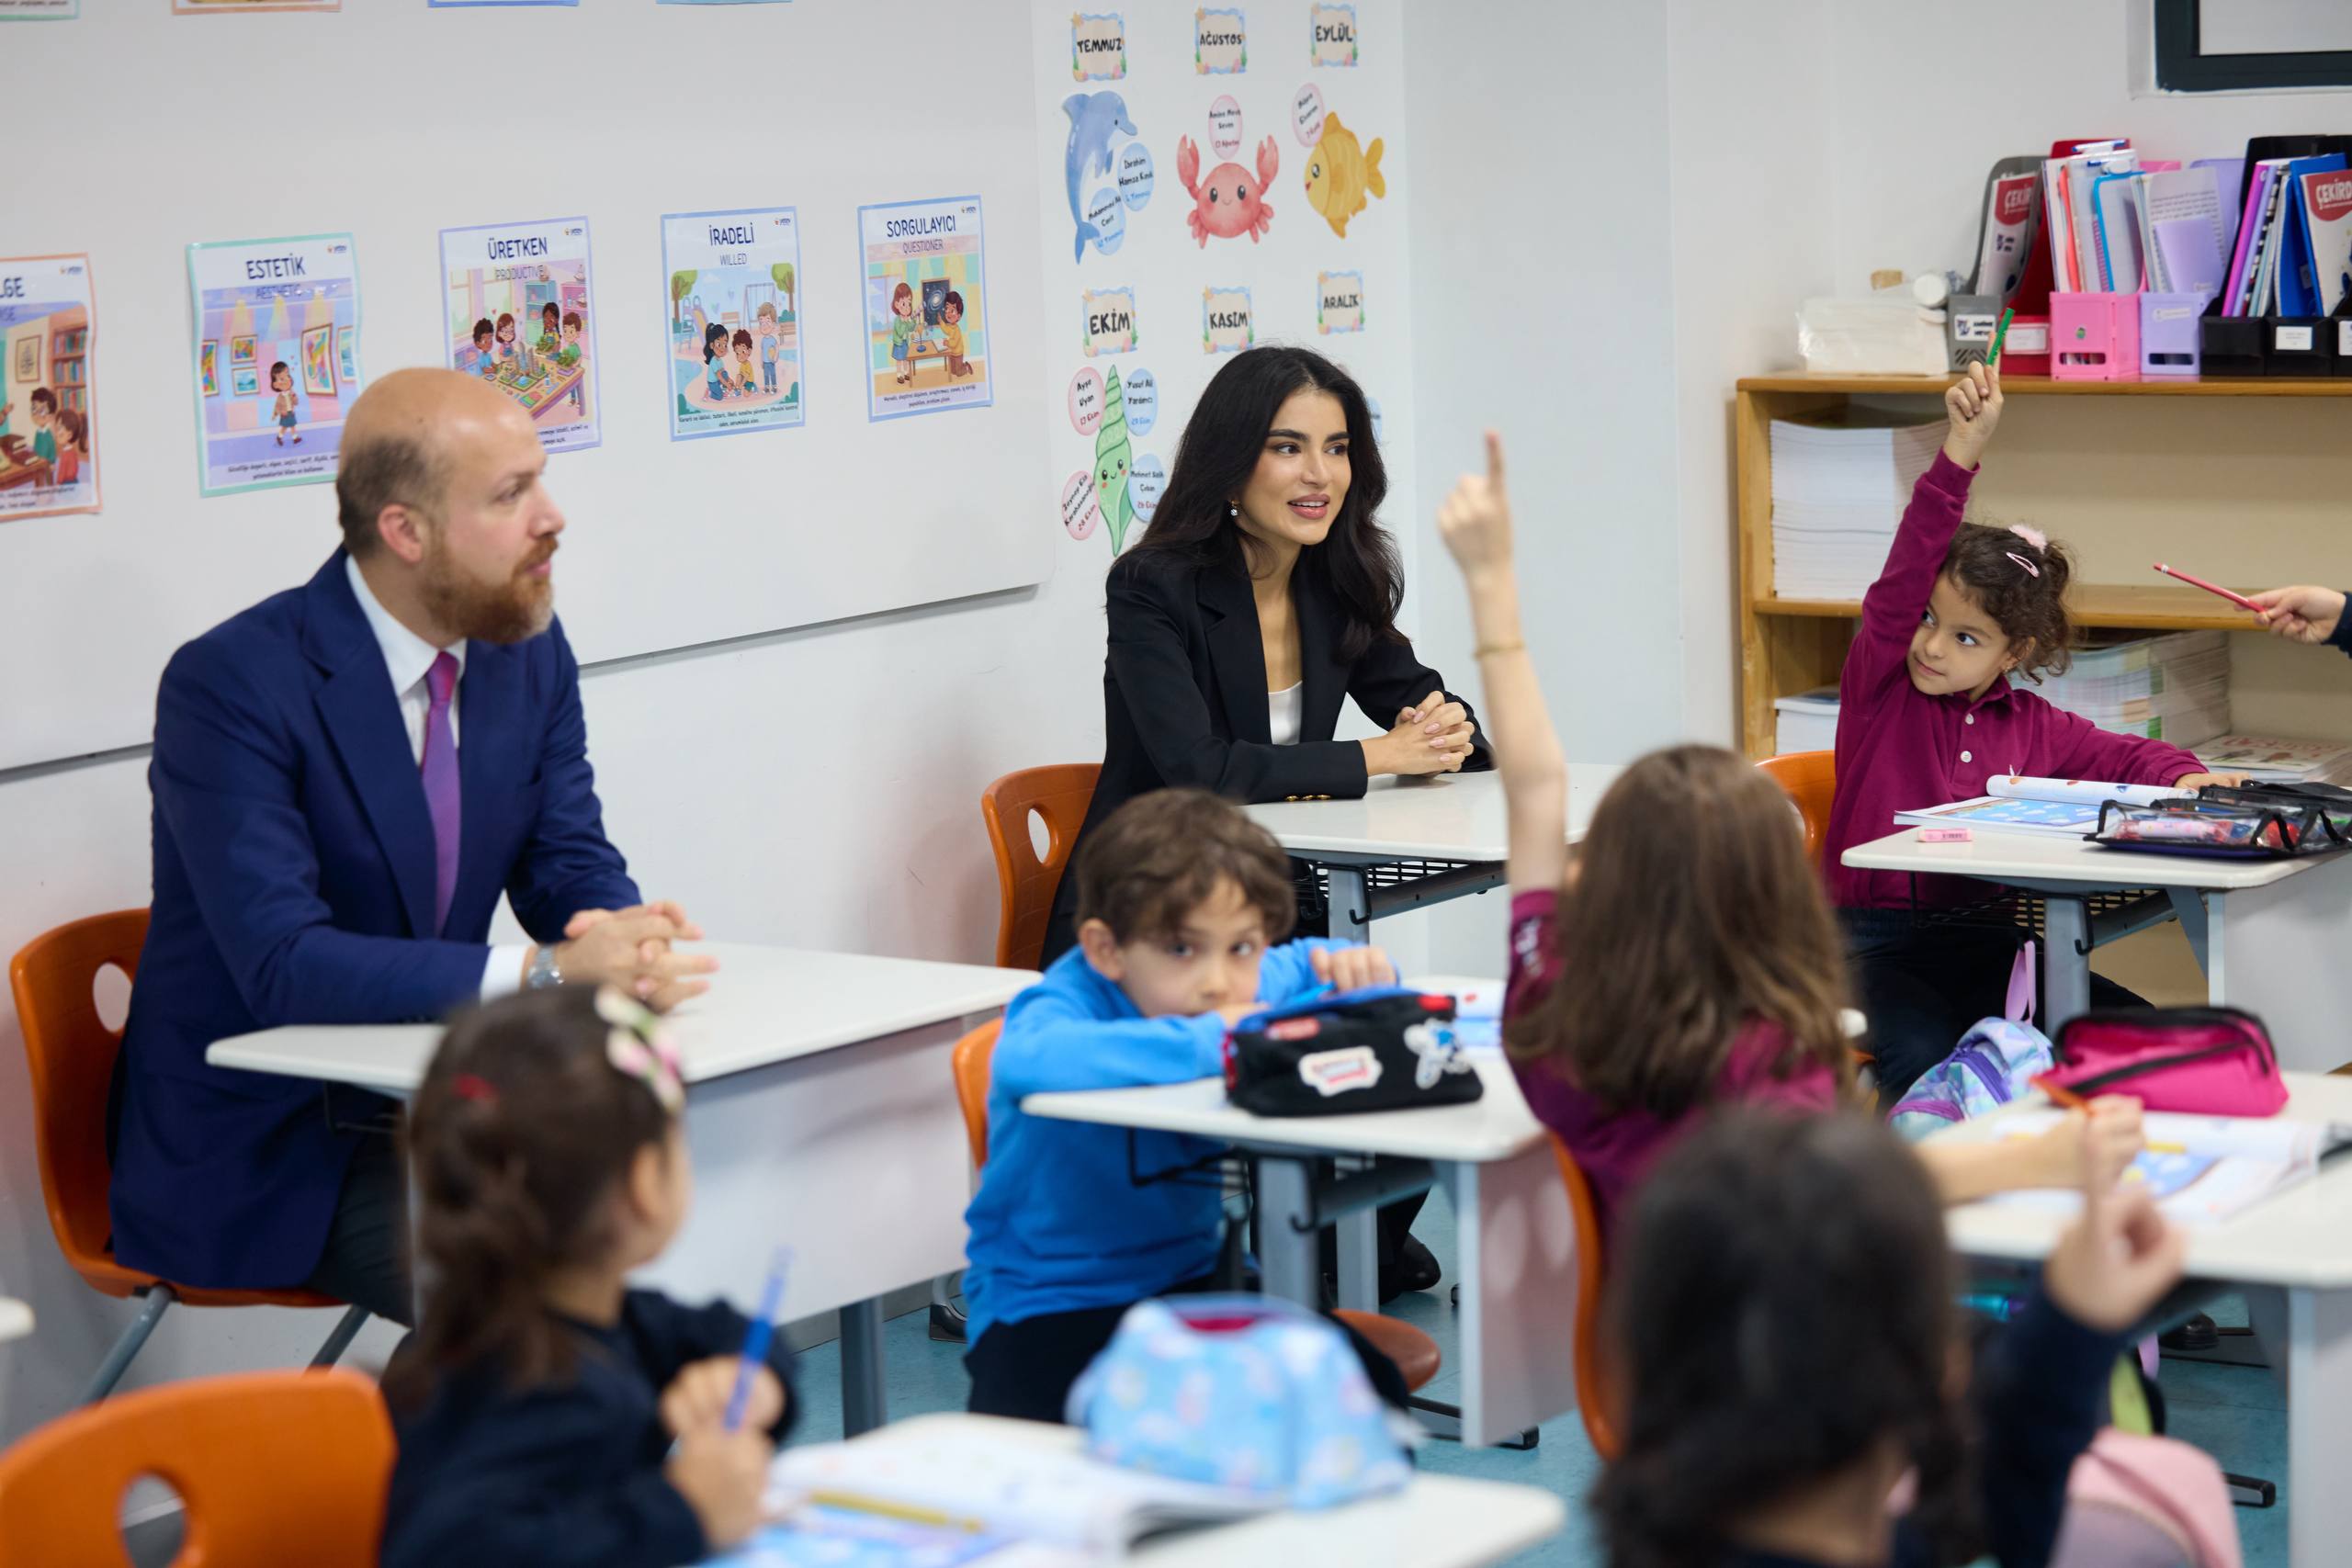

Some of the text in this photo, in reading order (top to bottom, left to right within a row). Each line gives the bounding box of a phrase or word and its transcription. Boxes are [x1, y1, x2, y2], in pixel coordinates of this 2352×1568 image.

[1200, 30, 1242, 46] AĞUSTOS
[1315, 22, 1353, 42] EYLÜL
[1077, 37, 1123, 53] TEMMUZ
[708, 221, 754, 246] İRADELİ
[887, 214, 956, 238] SORGULAYICI
[488, 237, 548, 260] ÜRETKEN
[902, 239, 944, 254] QUESTIONER
[245, 252, 307, 280] ESTETİK
[719, 253, 748, 265] WILLED
[1323, 293, 1360, 310] ARALIK
[1090, 308, 1130, 335] EKİM
[1209, 310, 1248, 330] KASIM
